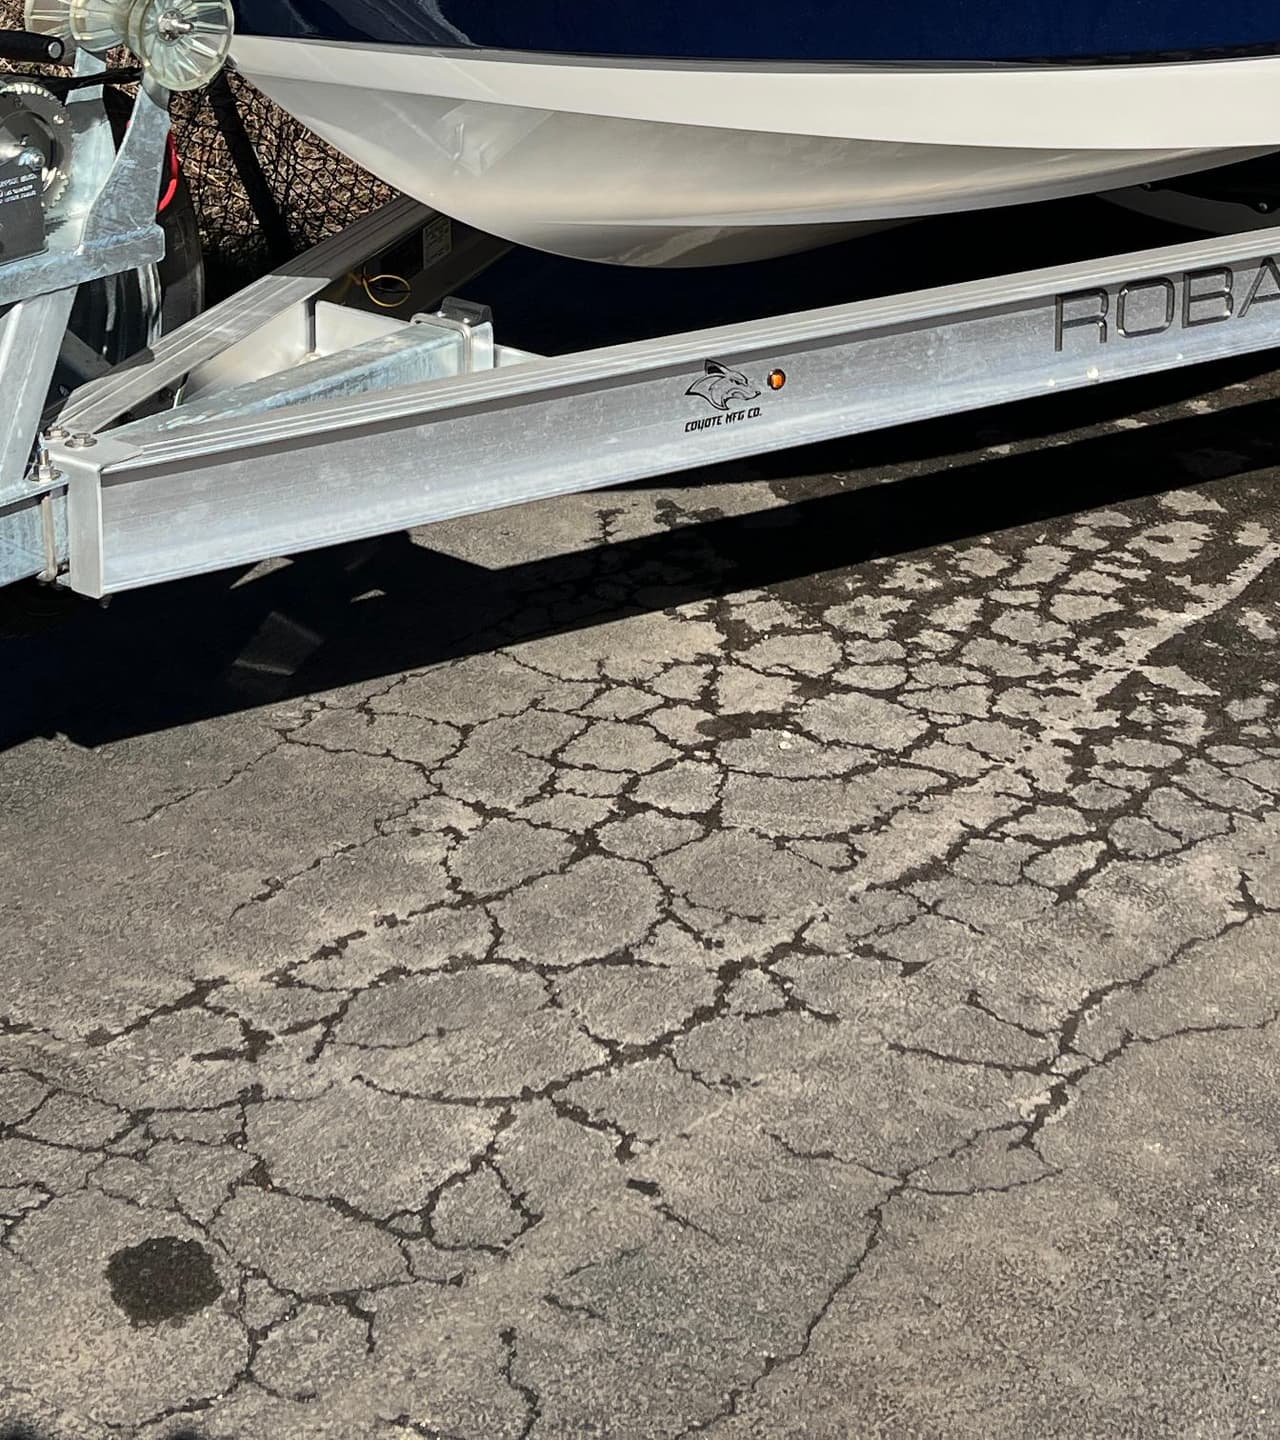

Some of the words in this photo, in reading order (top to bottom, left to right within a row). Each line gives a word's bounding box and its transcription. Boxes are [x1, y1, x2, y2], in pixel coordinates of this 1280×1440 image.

[684, 415, 723, 433] COYOTE
[725, 410, 745, 424] MFG
[747, 407, 763, 419] CO.
